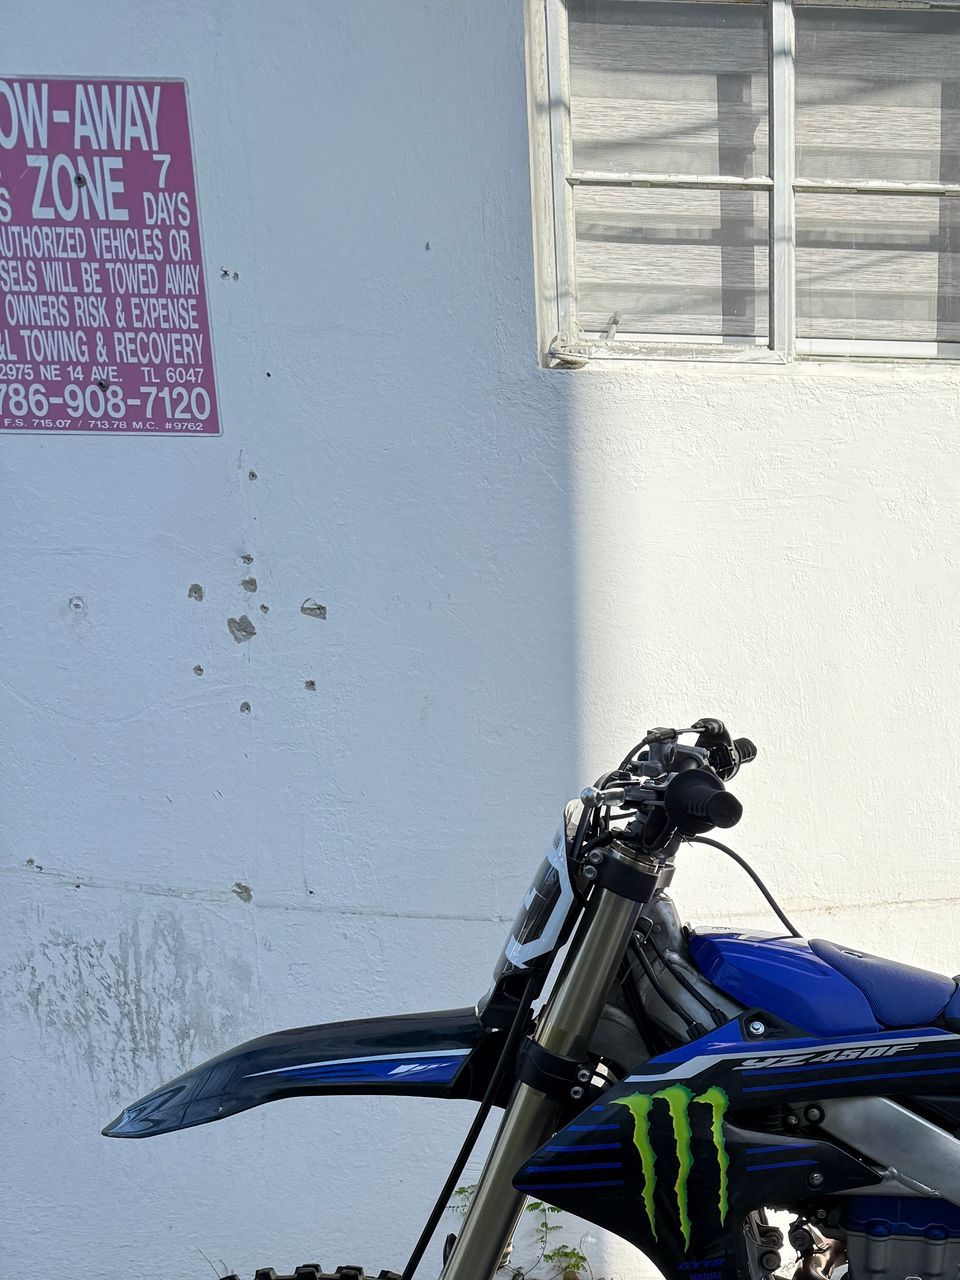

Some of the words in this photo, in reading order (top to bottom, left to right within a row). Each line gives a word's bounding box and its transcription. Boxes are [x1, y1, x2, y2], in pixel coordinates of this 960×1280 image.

[26, 153, 129, 222] ZONE
[153, 154, 171, 188] 7
[143, 191, 191, 227] DAYS
[91, 227, 163, 262] VEHICLES
[169, 228, 192, 261] OR
[41, 261, 78, 293] WILL
[81, 262, 103, 294] BE
[105, 262, 159, 295] TOWED
[165, 264, 200, 295] AWAY
[5, 294, 70, 327] OWNERS
[74, 296, 111, 328] RISK
[115, 297, 126, 328] &
[131, 297, 199, 330] EXPENSE
[20, 329, 89, 363] TOWING
[96, 330, 109, 363] &
[113, 331, 203, 365] RECOVERY
[40, 364, 61, 381] NE
[66, 365, 84, 381] 14
[90, 366, 123, 382] AVE.
[141, 367, 160, 382] TL
[165, 367, 204, 383] 6047
[32, 419, 72, 428] 715.07
[88, 420, 127, 429] 713.78
[165, 422, 204, 431] #9762
[732, 1043, 919, 1071] YZ450F
